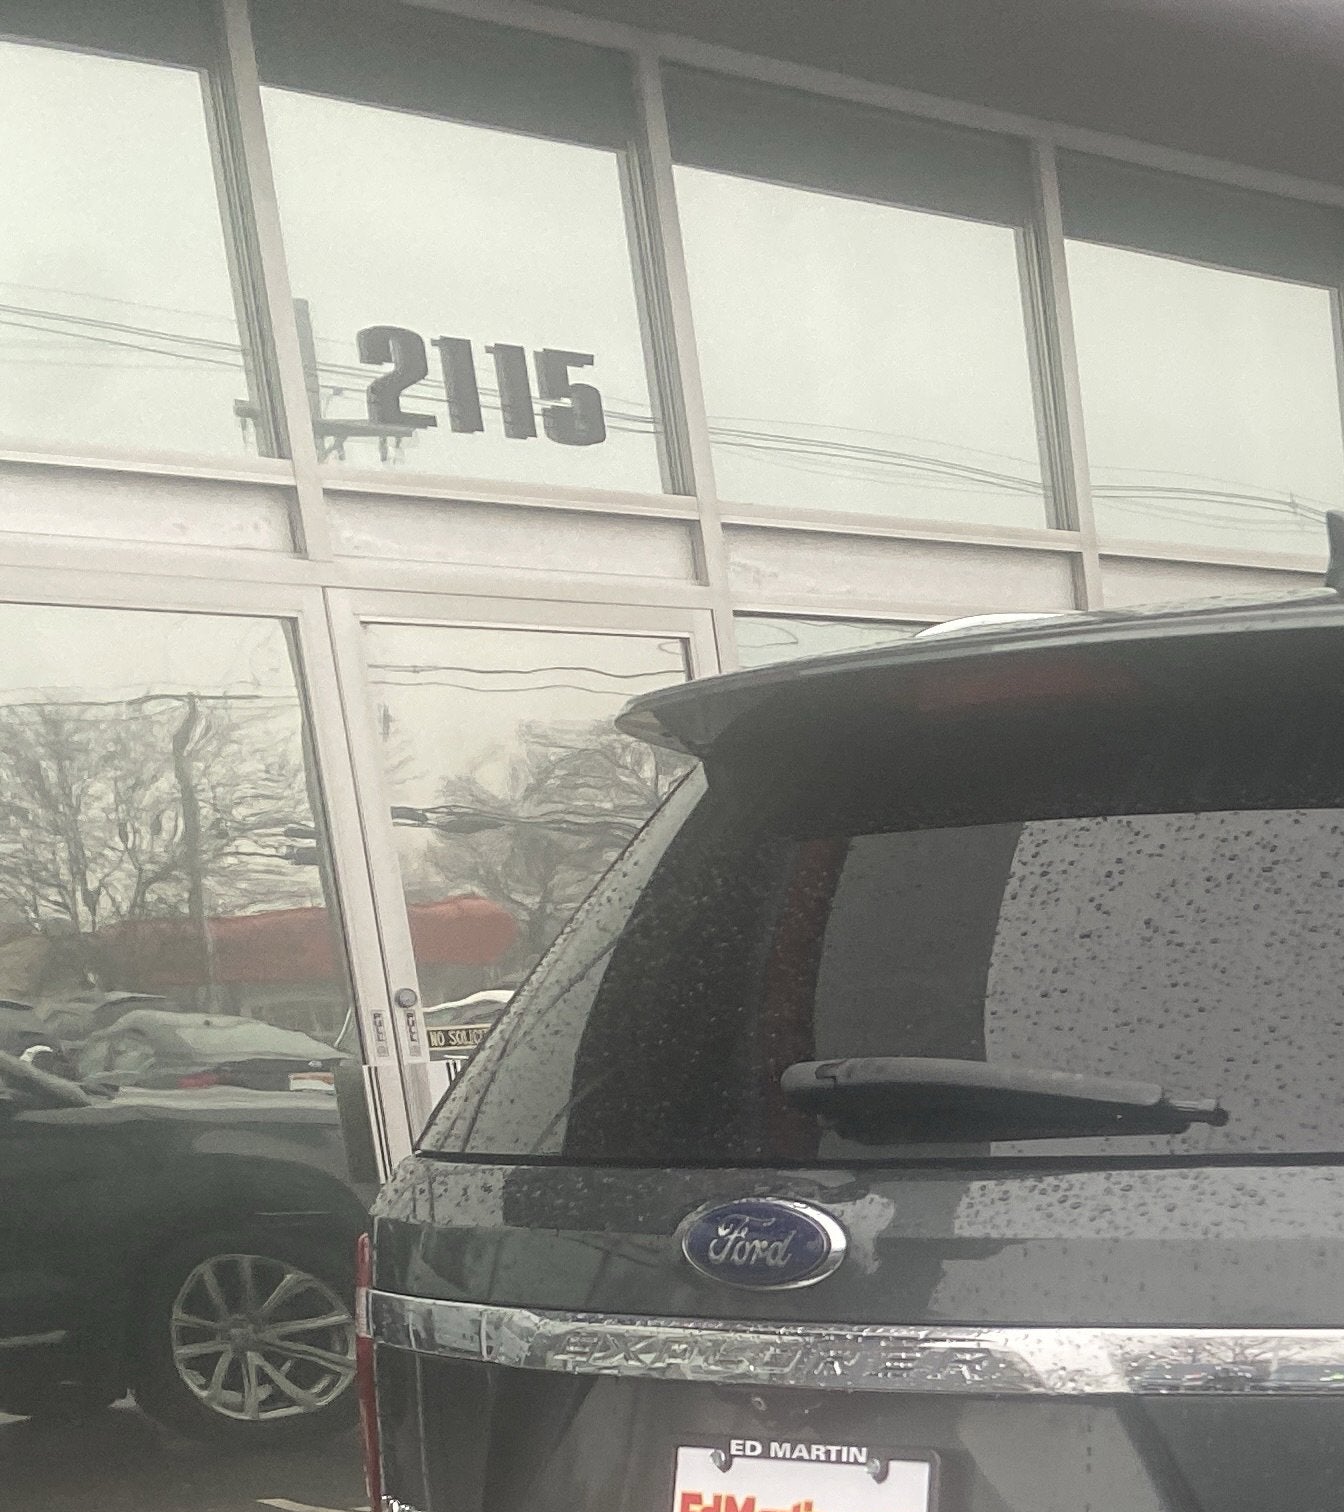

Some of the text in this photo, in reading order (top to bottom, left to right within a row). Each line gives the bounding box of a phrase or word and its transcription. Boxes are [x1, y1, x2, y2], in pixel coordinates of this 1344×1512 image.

[357, 325, 606, 446] 2115
[430, 1031, 445, 1046] NO
[708, 1213, 797, 1267] Ford
[730, 1439, 868, 1464] ED MARTIN
